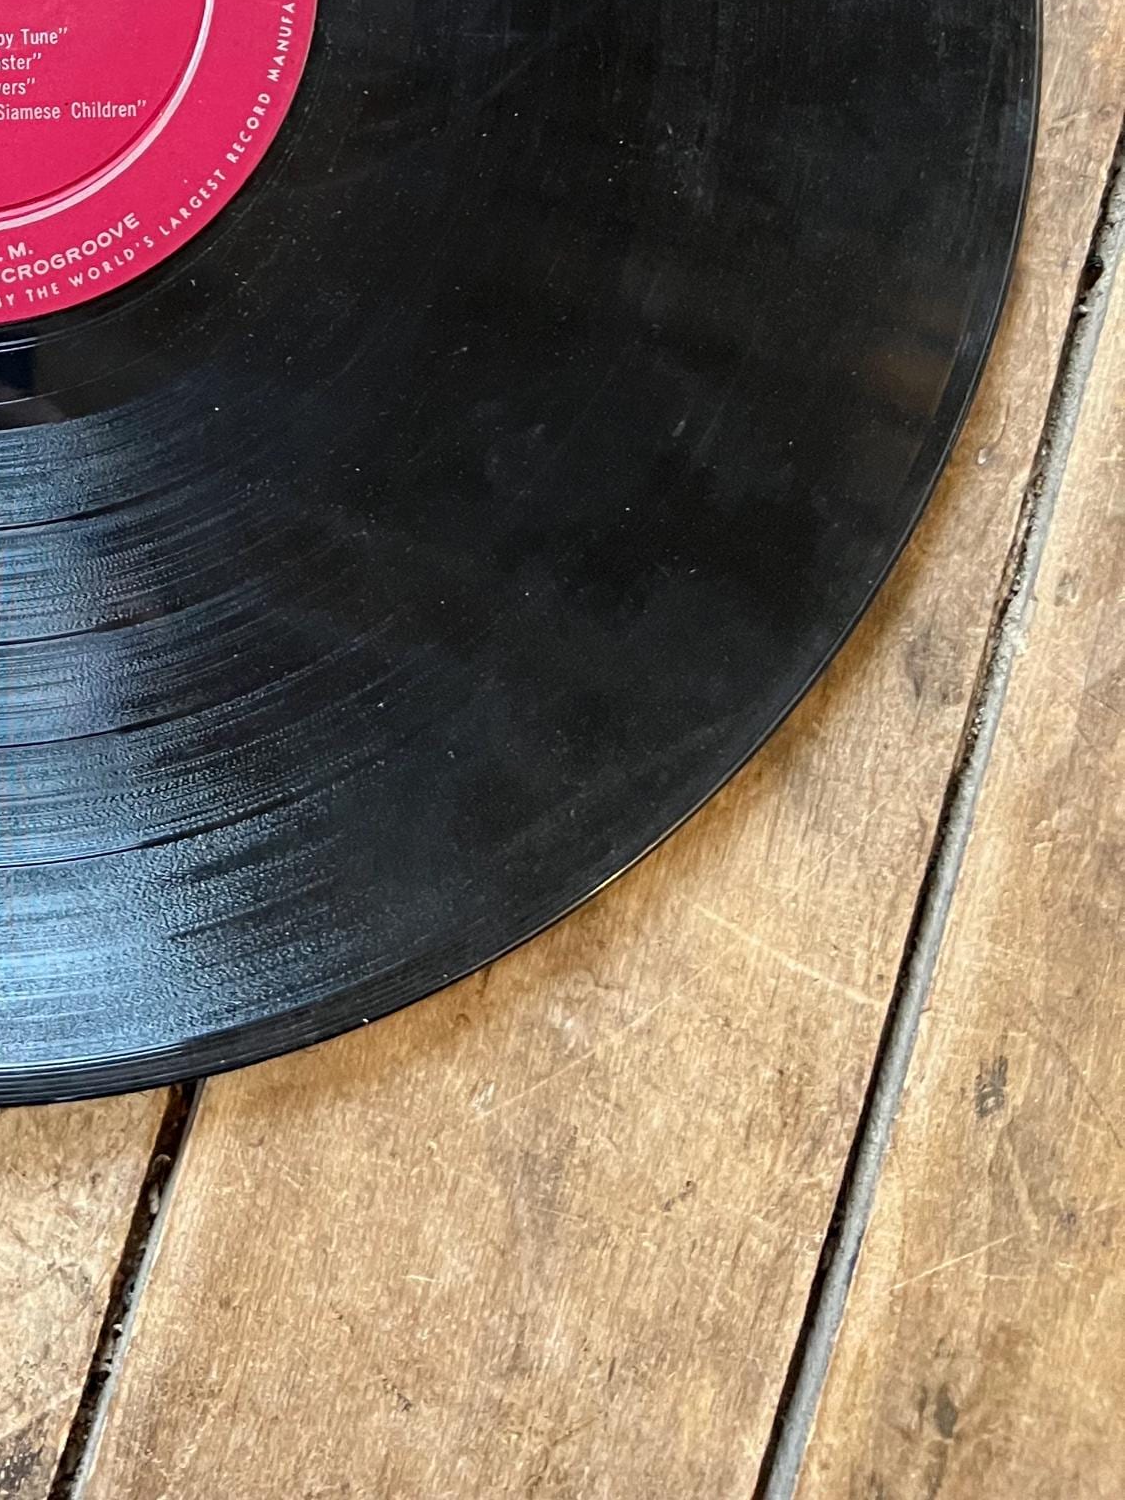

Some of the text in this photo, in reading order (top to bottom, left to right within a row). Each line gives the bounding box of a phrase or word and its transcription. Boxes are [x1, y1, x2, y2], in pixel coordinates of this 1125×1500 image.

[25, 282, 60, 302] THE
[68, 236, 154, 287] WORLD'S
[159, 168, 226, 236] LARGEST
[226, 93, 271, 164] RECORD
